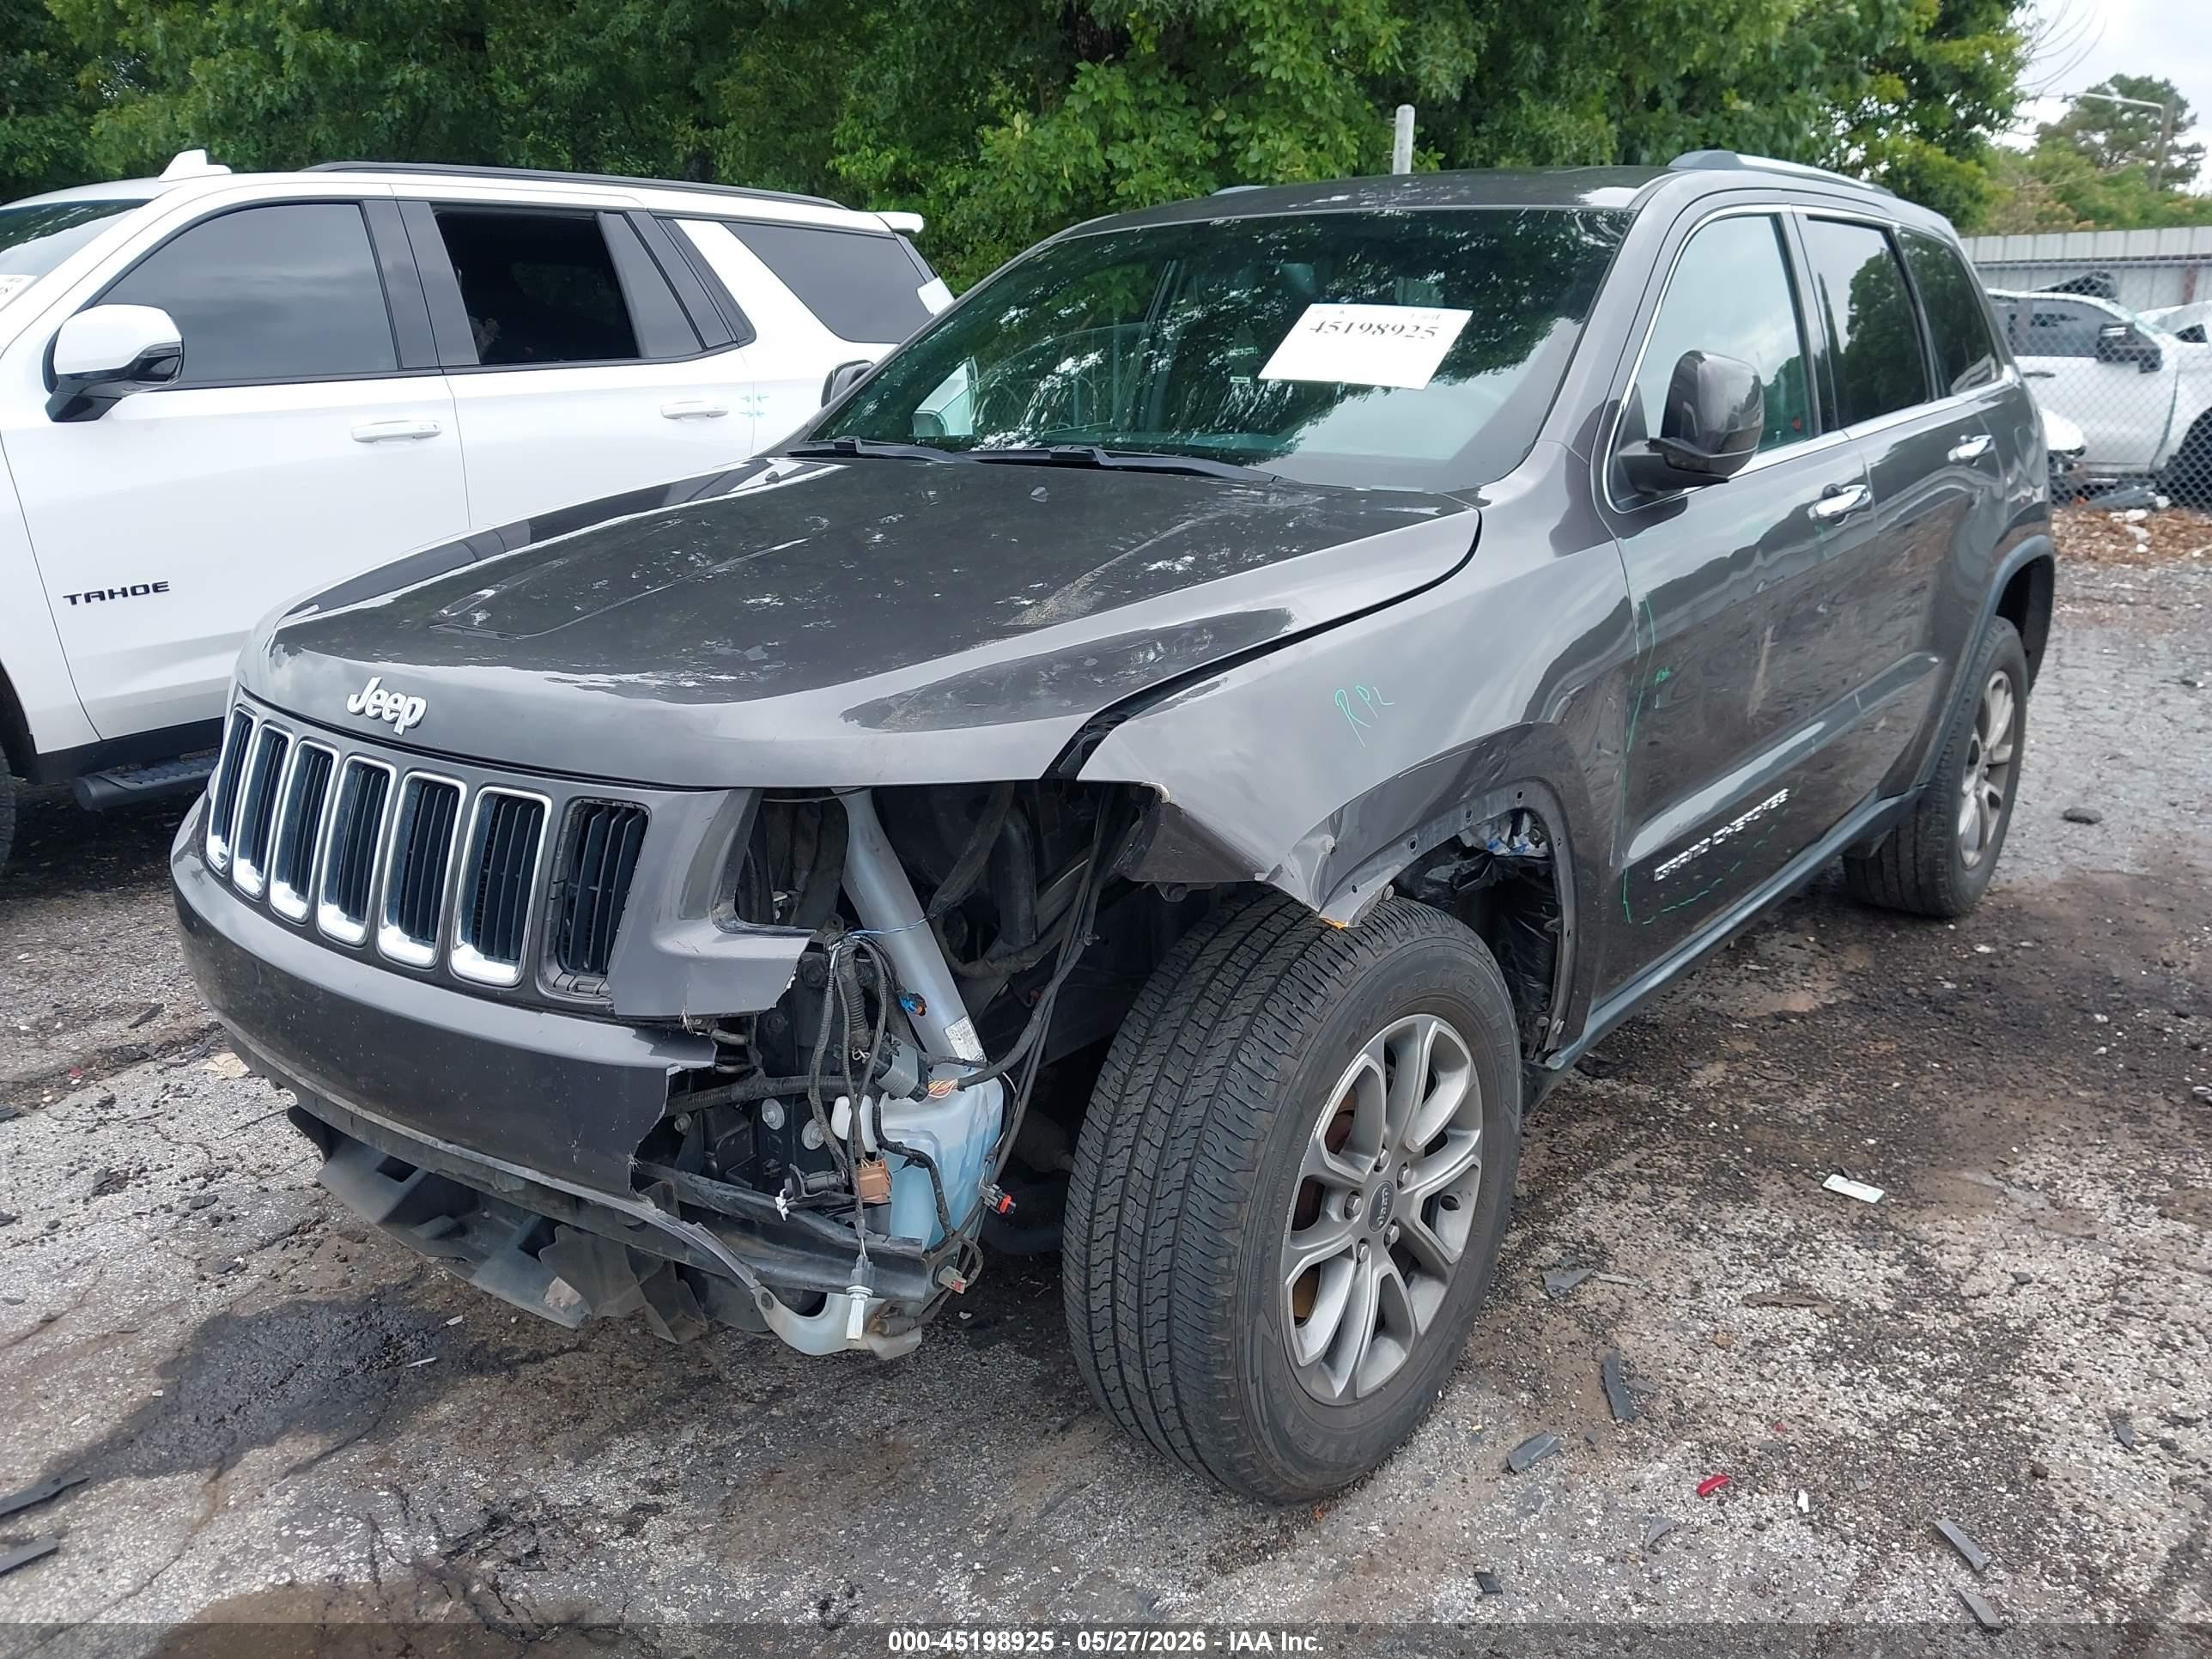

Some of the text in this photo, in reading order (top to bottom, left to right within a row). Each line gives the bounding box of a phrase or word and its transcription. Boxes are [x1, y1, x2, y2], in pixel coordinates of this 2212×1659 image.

[1310, 320, 1440, 339] 45198925
[63, 580, 170, 606] TAHOE
[346, 676, 428, 736] Jeep
